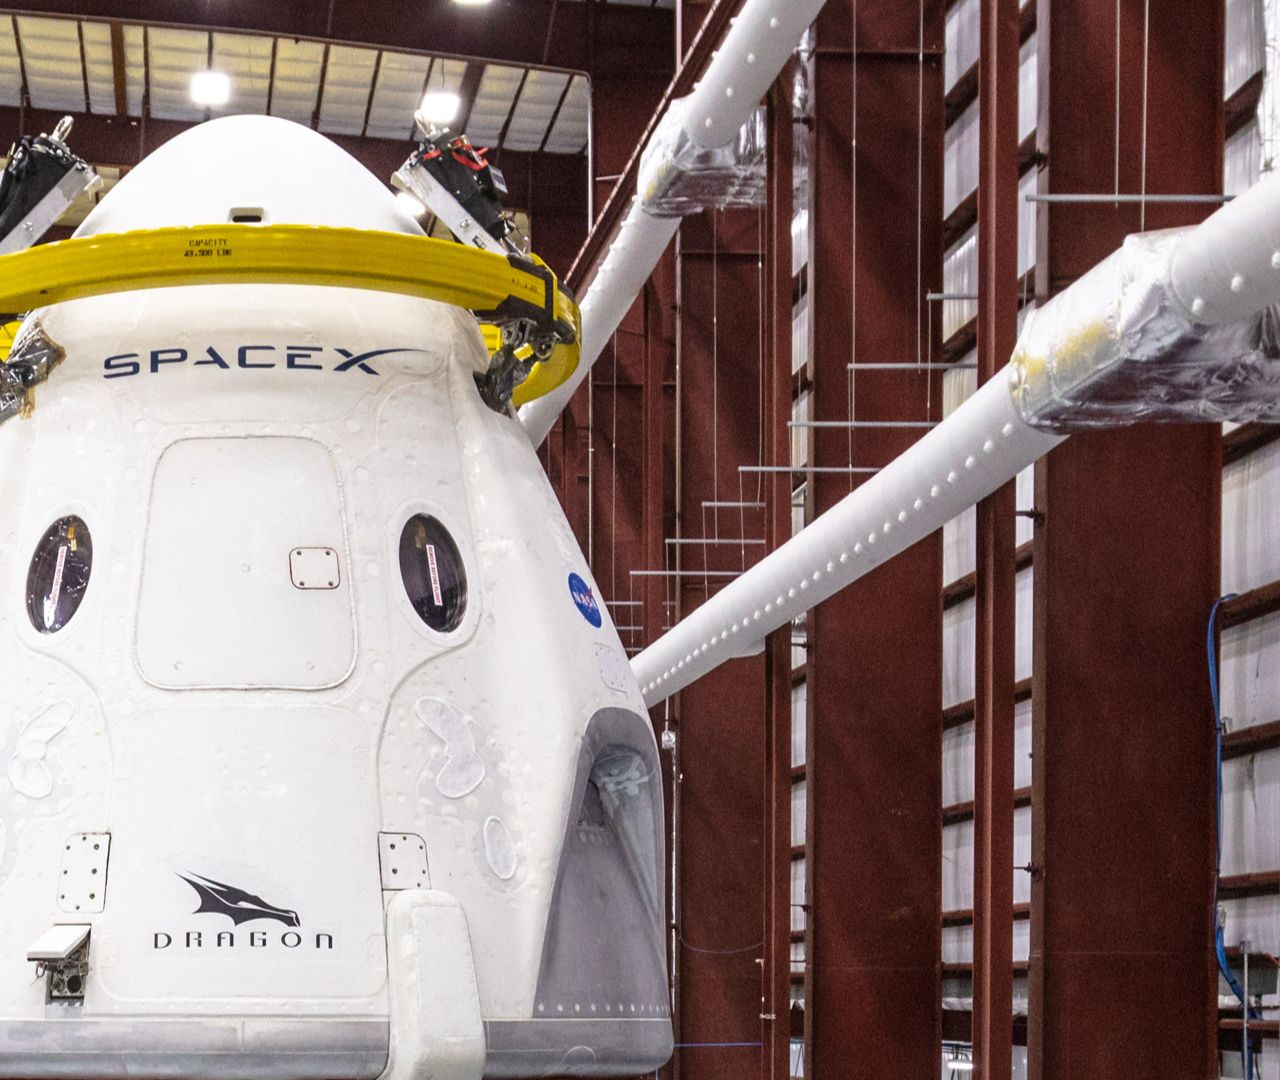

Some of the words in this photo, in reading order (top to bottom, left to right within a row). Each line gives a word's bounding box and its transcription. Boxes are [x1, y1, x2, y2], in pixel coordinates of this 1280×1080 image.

[188, 238, 228, 247] CAPACITY
[103, 345, 431, 379] SPACEX
[572, 591, 598, 609] NASA
[153, 931, 333, 949] DRAGON
